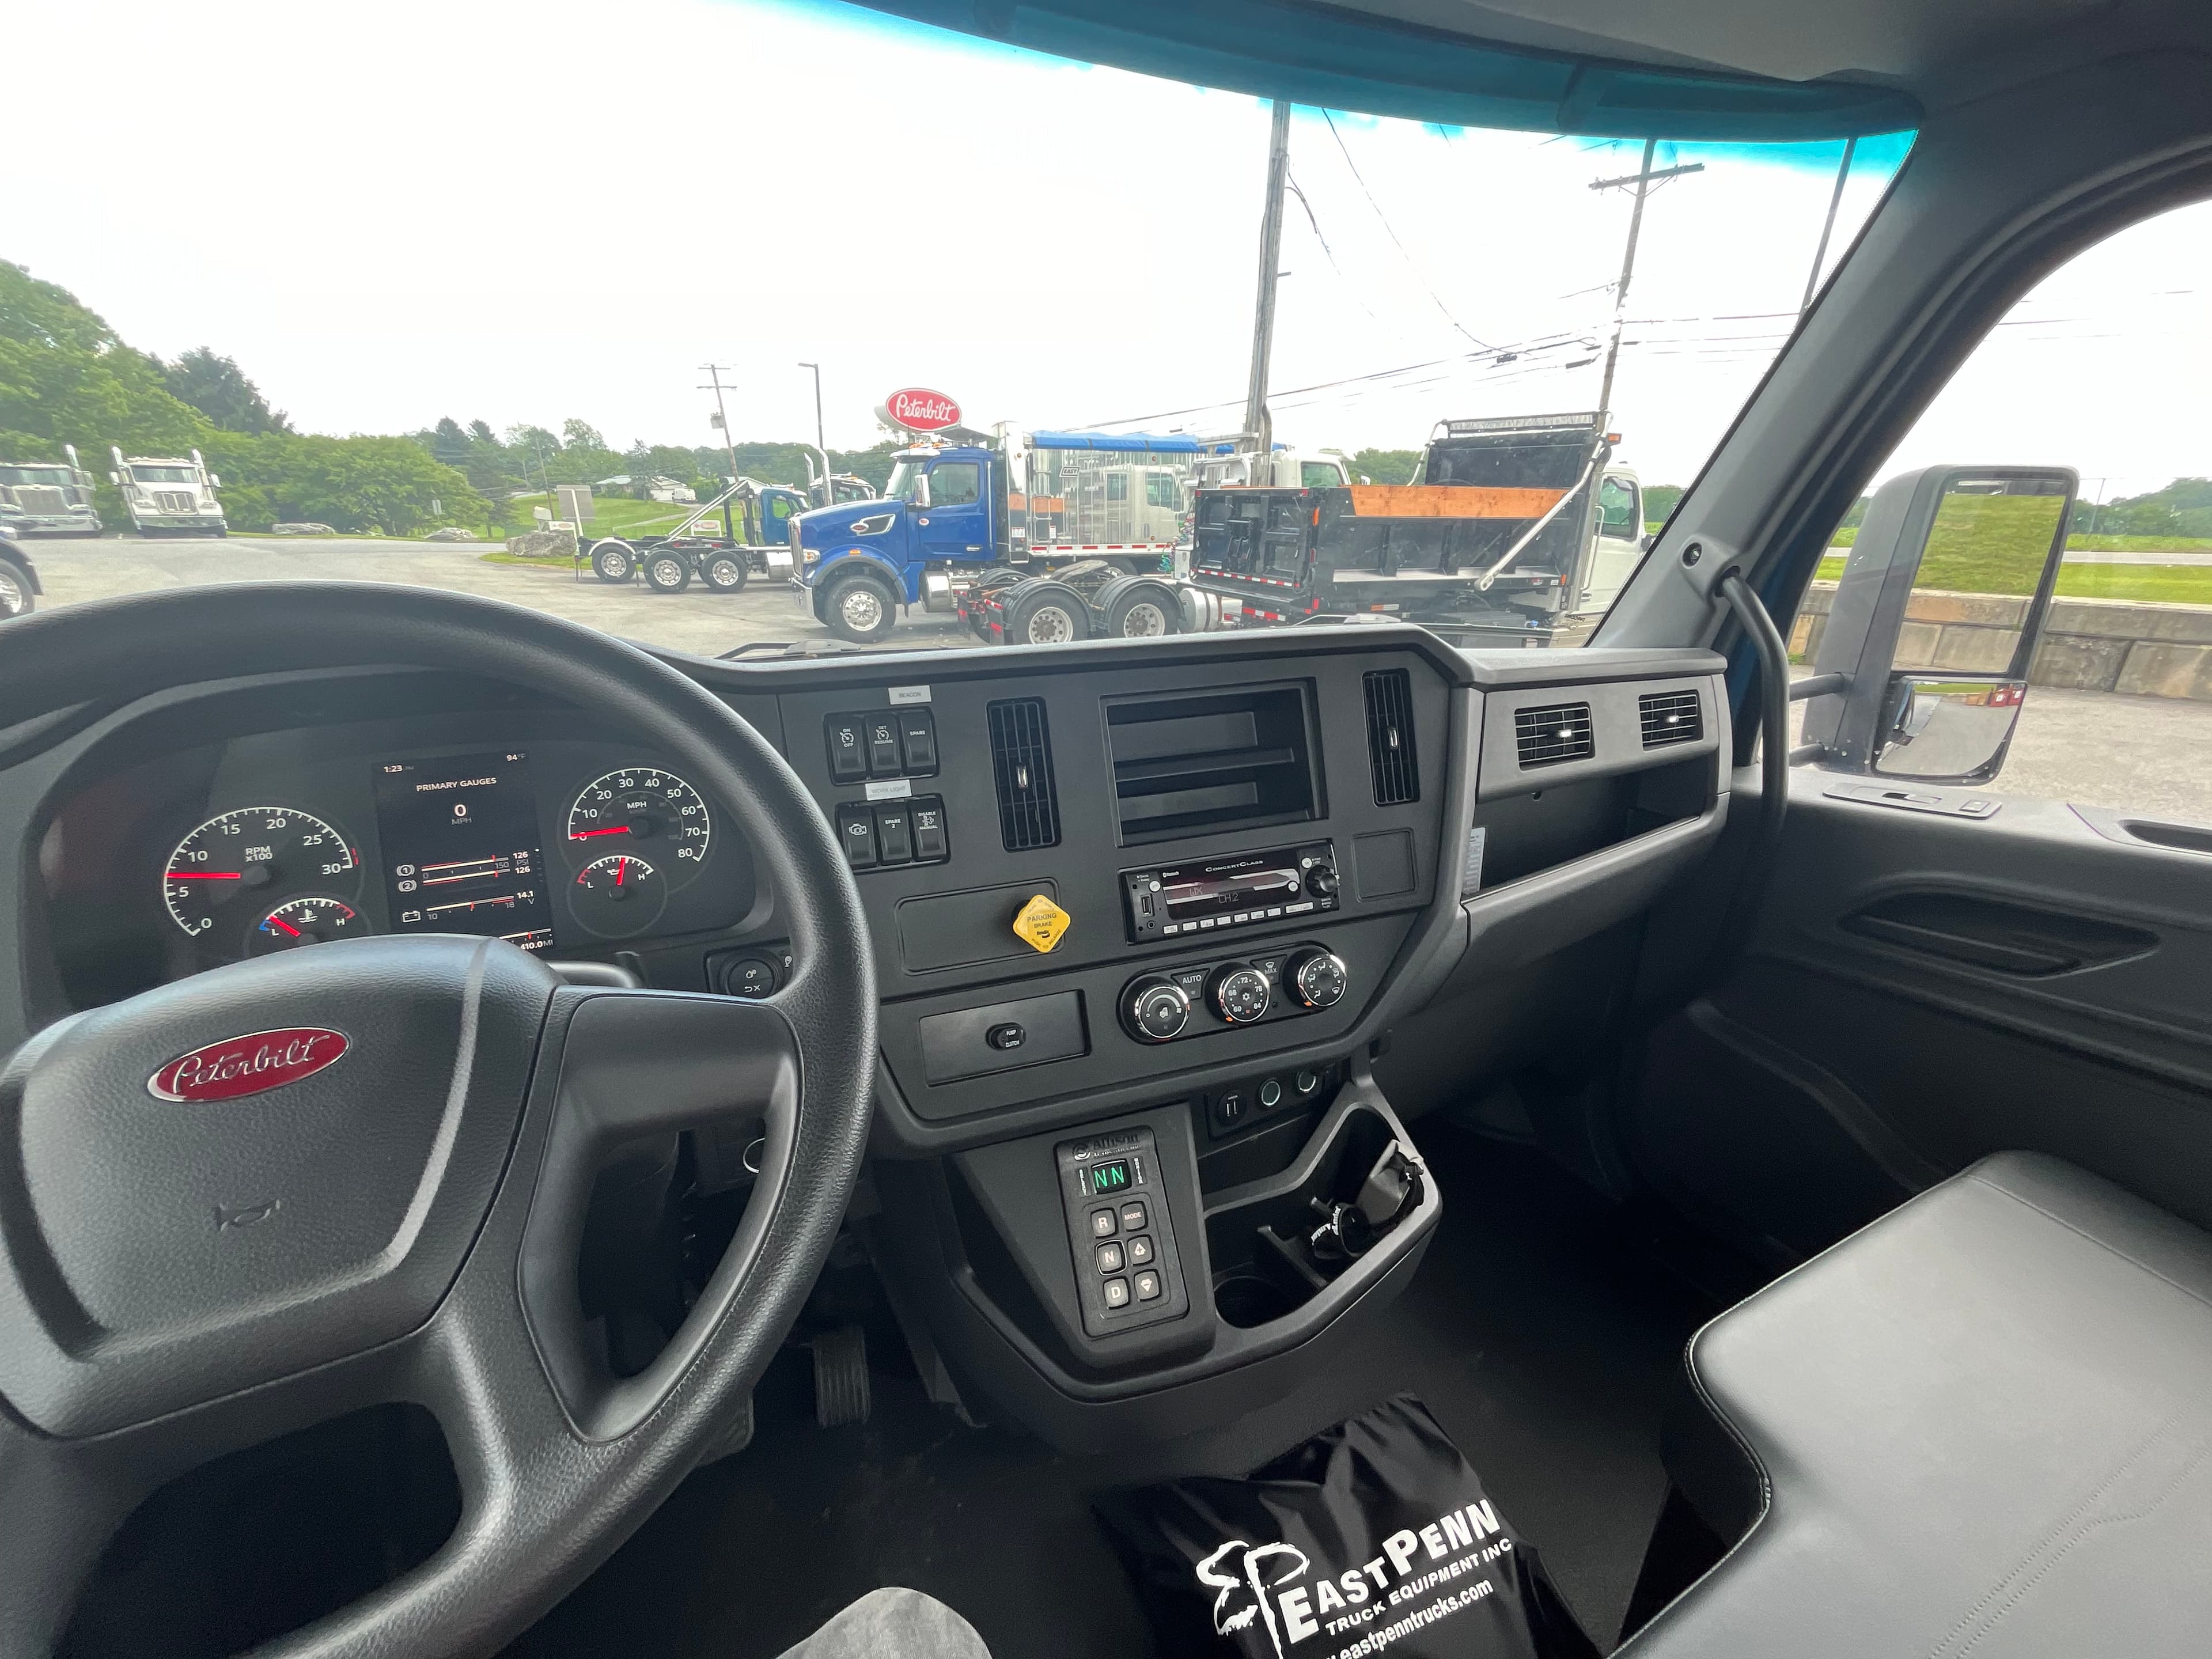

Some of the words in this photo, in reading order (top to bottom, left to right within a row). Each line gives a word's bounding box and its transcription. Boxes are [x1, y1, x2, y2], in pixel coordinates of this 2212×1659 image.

[896, 393, 956, 422] Peterbilt
[384, 764, 403, 772] 1:23
[416, 781, 458, 792] PRIMARY
[460, 777, 497, 787] GAUGES
[618, 778, 634, 788] 30
[645, 778, 660, 788] 40
[596, 790, 612, 800] 20
[666, 789, 682, 799] 50
[454, 803, 467, 817] 0
[627, 801, 647, 810] MPH
[681, 805, 696, 816] 60
[583, 808, 598, 819] 10
[267, 817, 287, 830] 20
[452, 816, 472, 825] MPH
[221, 823, 241, 835] 15
[685, 826, 700, 837] 70
[303, 834, 323, 846] 25
[245, 845, 271, 855] RPM
[513, 851, 529, 859] 126
[677, 847, 693, 858] 80
[188, 850, 208, 862] 10
[246, 852, 273, 862] x100
[321, 863, 342, 875] 30
[515, 866, 531, 874] 126
[637, 873, 646, 881] H
[179, 886, 190, 898] 5
[517, 891, 535, 899] 14.1
[336, 918, 346, 926] H
[1027, 912, 1057, 922] PARKING
[200, 917, 213, 929] 0
[271, 928, 279, 936] L
[1182, 975, 1202, 984] AUTO
[172, 1035, 330, 1094] Peterbilt
[1124, 1211, 1142, 1221] MODE
[1097, 1217, 1108, 1229] R
[1104, 1251, 1115, 1263] N
[1111, 1286, 1120, 1299] D
[1325, 1602, 1387, 1636] TRUCK
[1388, 1554, 1480, 1606] EQUIPMENT
[1481, 1537, 1513, 1563] INC
